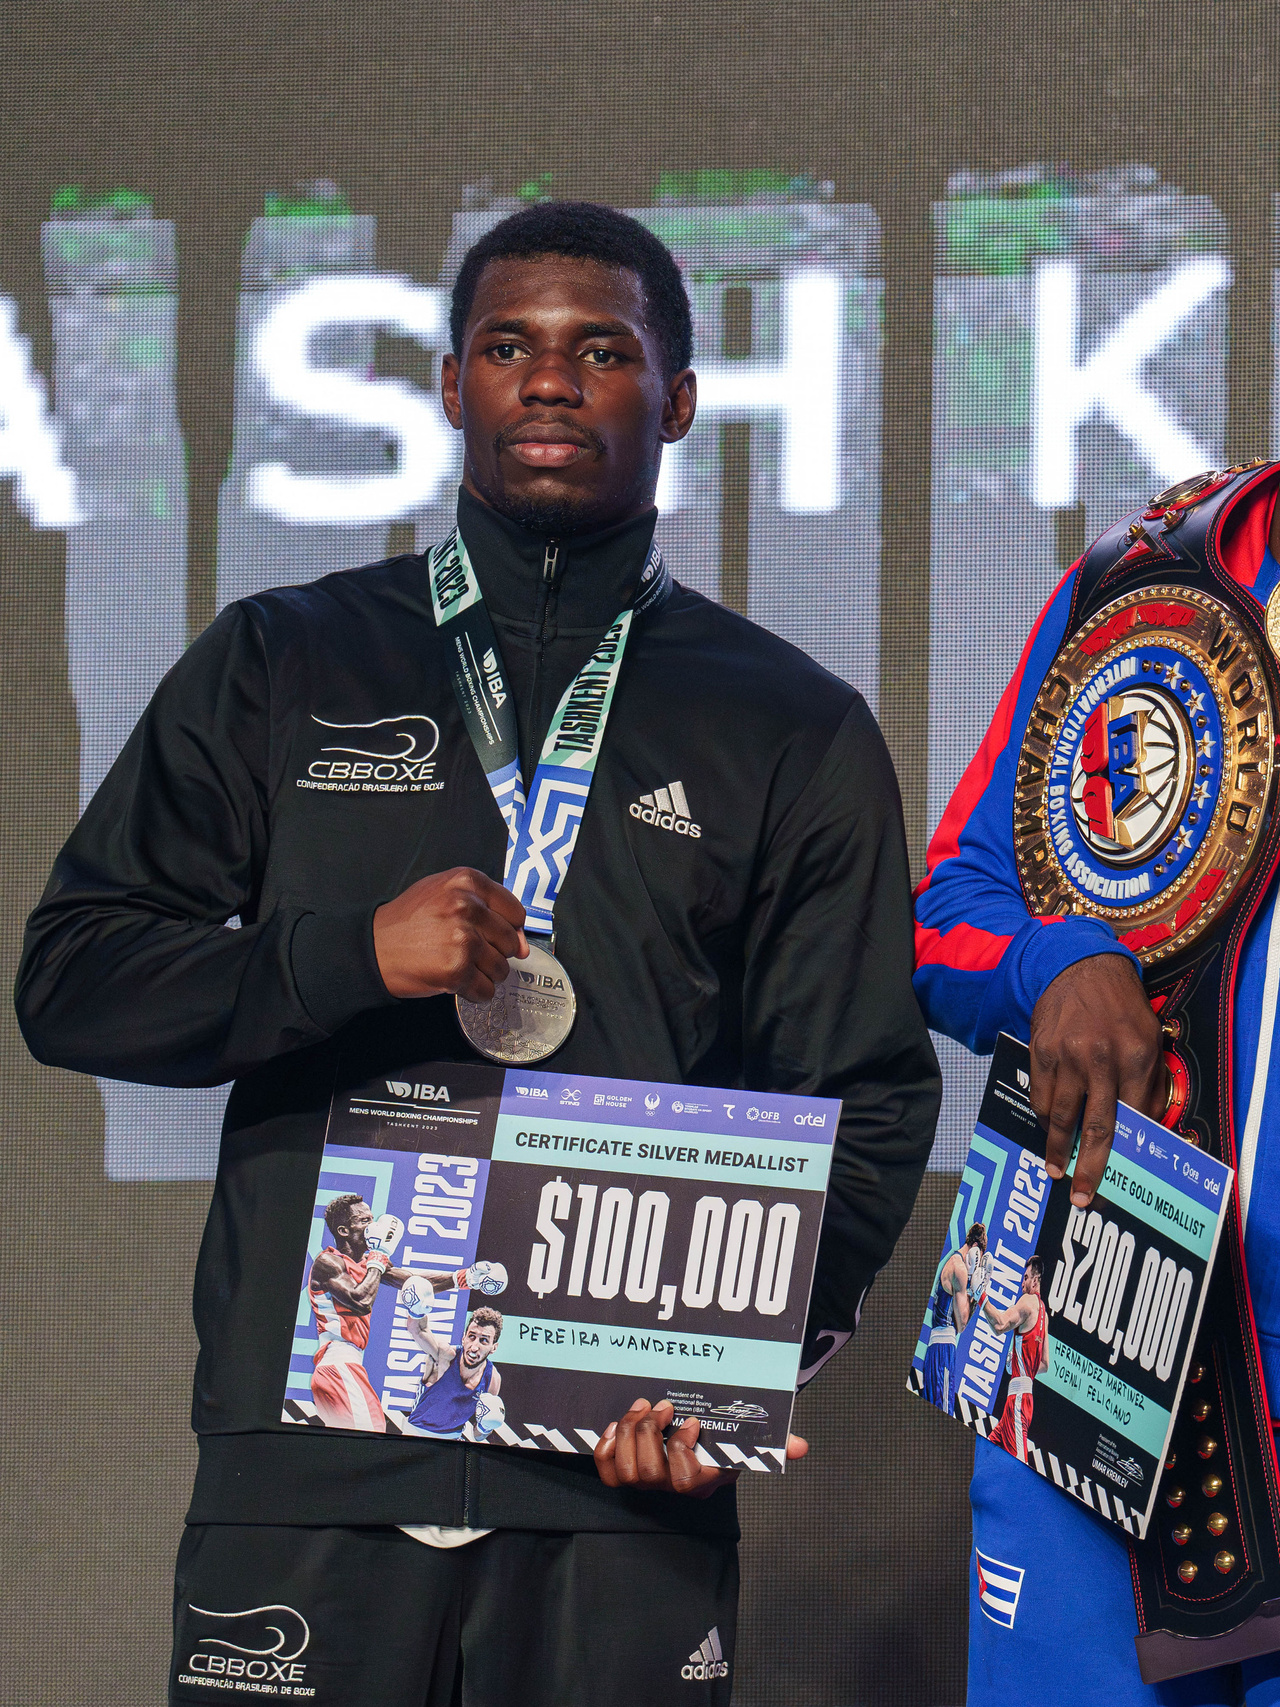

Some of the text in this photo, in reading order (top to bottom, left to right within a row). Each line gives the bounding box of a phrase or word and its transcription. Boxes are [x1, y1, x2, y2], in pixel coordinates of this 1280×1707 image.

[435, 555, 469, 610] 2023
[455, 636, 495, 746] MENS WORLD BOXING CHAMPIONSHIPS
[486, 671, 507, 709] IBA
[553, 671, 611, 753] TASHKENT
[1208, 624, 1264, 834] WORLD
[308, 761, 436, 780] CBBOXE
[1049, 656, 1150, 900] INTERNATIONAL BOXING ASSOCIATION
[1107, 711, 1140, 814] IBA
[362, 783, 408, 793] BRASILEIRA
[410, 783, 421, 791] DE
[423, 782, 445, 790] BOXE
[629, 803, 702, 838] adidas
[536, 975, 565, 991] IBA
[413, 1083, 450, 1102] IBA
[529, 1088, 549, 1098] IBA
[349, 1107, 479, 1125] MENS WORLD BOXING CHAMPIONSHIPS
[760, 1110, 780, 1121] OFB
[793, 1112, 827, 1128] artel
[515, 1131, 809, 1173] CERTIFICATE SILVER MEDALLIST
[1189, 1168, 1199, 1181] OFB
[1203, 1177, 1221, 1196] artel
[407, 1153, 479, 1240] 2023
[1003, 1148, 1049, 1243] 2023
[1129, 1181, 1153, 1207] GOLD
[1154, 1195, 1206, 1239] MEDALLIST
[527, 1175, 801, 1322] $100,000
[1048, 1204, 1194, 1382] $200,000
[519, 1322, 725, 1362] PEREIRA WANDERLEY
[1054, 1341, 1145, 1411] HERNANDEZ MARTINEZ
[666, 1390, 689, 1399] President
[695, 1400, 712, 1408] Boxing
[1086, 1385, 1132, 1426] FELICIANO
[699, 1420, 740, 1432] REMLEV
[1092, 1458, 1128, 1488] UMAR KREMLEV
[188, 1653, 307, 1682] CBBOXE
[681, 1658, 729, 1681] adidas
[236, 1681, 278, 1694] BRASILEIRA
[281, 1686, 291, 1695] DE
[293, 1687, 316, 1697] BOXE
